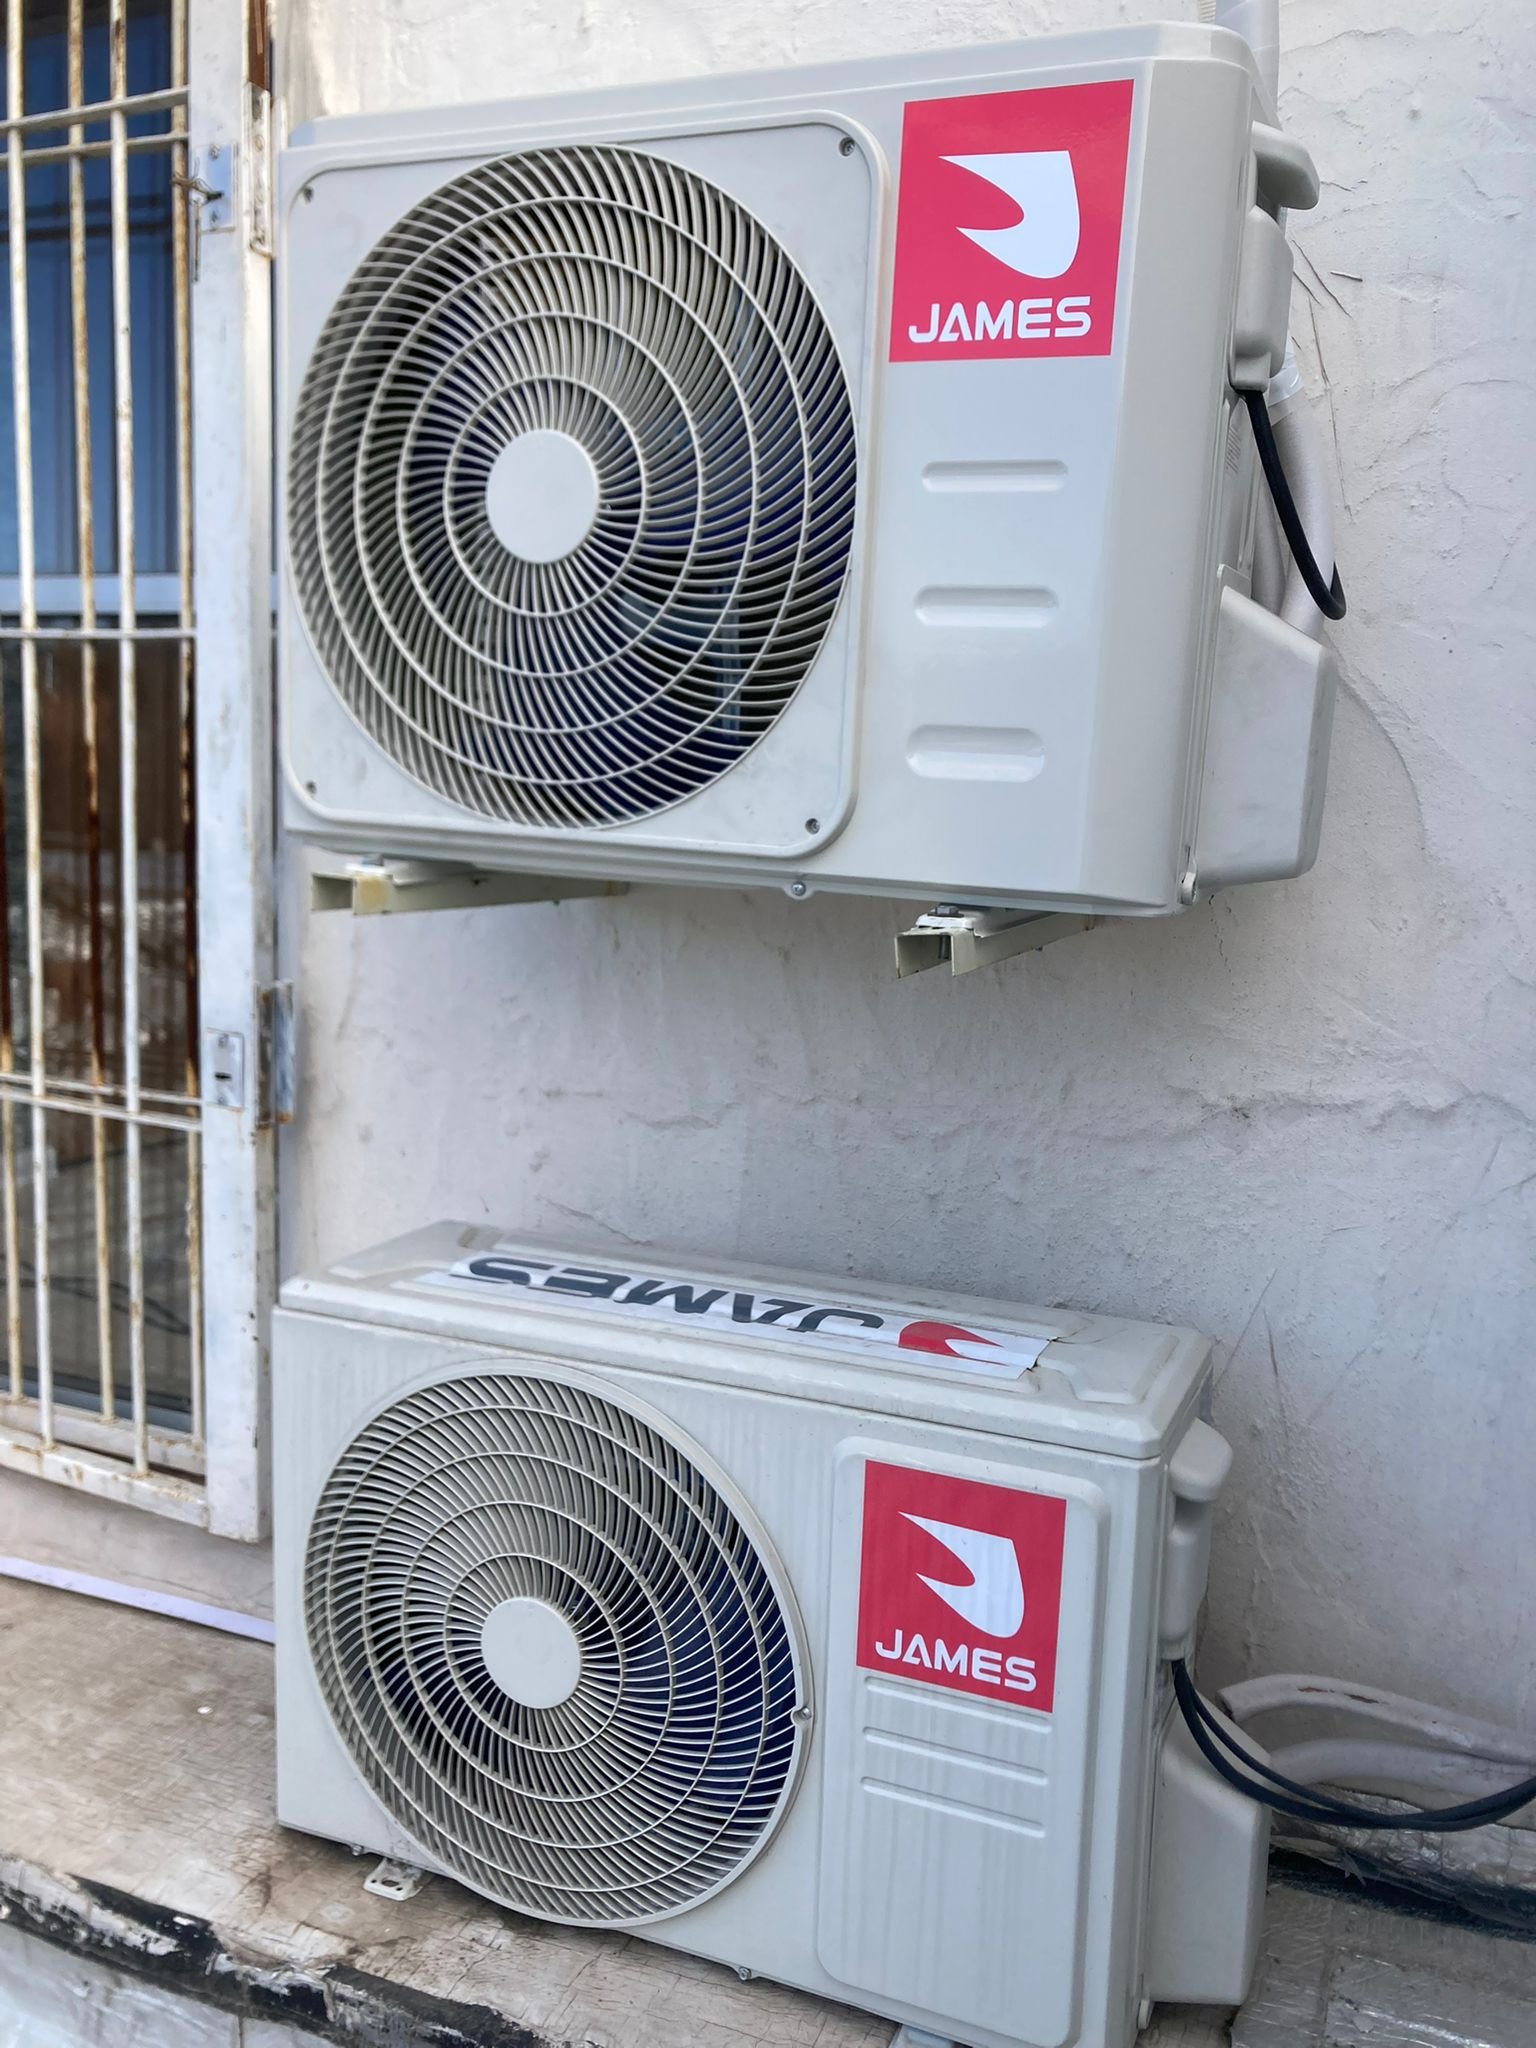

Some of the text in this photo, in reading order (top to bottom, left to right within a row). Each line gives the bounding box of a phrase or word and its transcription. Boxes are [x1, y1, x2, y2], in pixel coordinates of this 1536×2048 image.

[908, 296, 1092, 343] JAMES
[469, 1257, 884, 1333] JAMES
[875, 1629, 1037, 1692] JAMES
